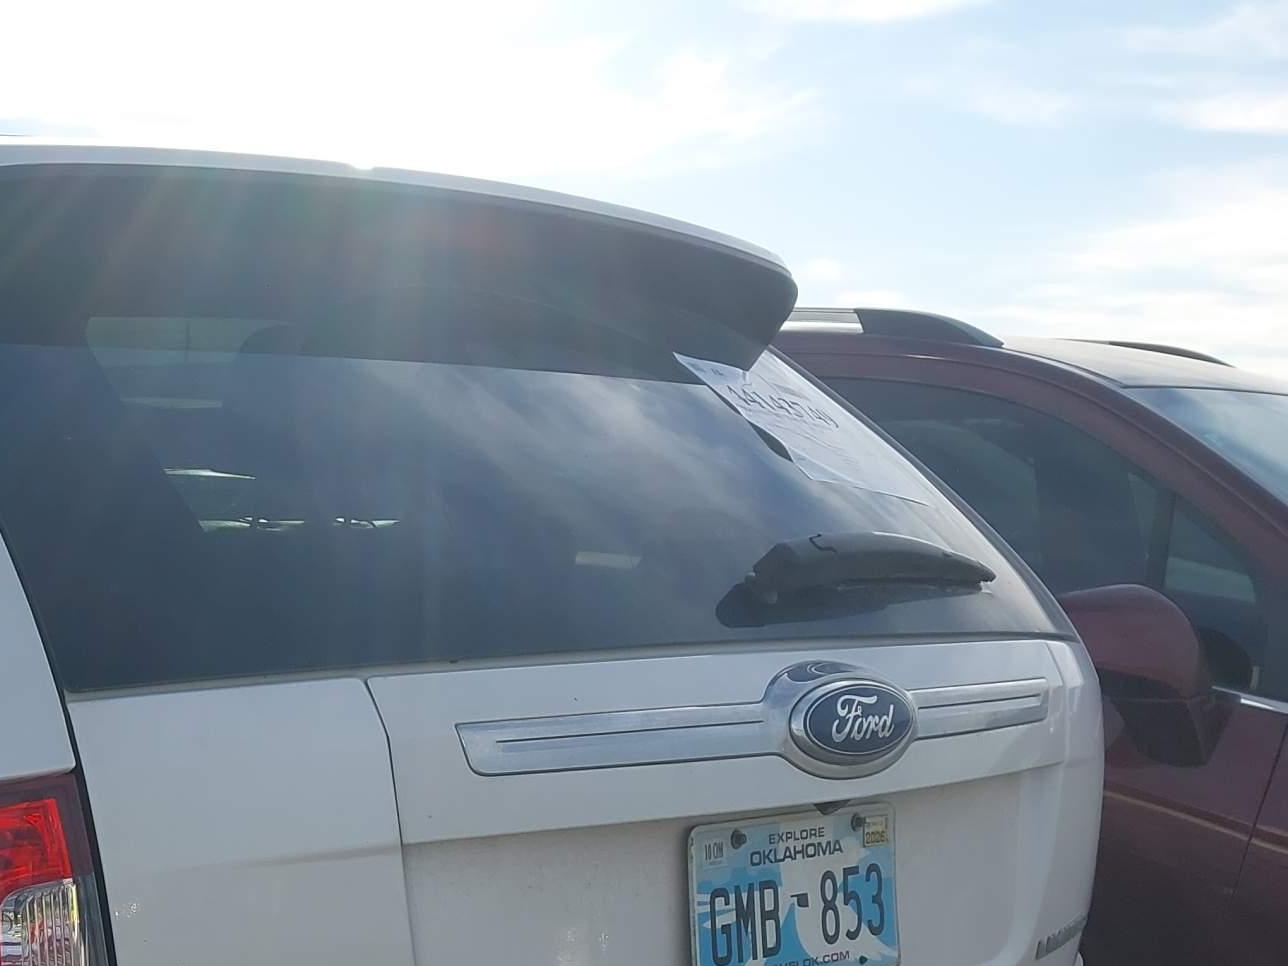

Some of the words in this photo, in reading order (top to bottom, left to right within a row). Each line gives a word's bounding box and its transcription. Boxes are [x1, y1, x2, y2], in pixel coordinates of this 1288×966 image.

[832, 694, 895, 742] Ford
[750, 839, 844, 866] OKLAHOMA
[768, 826, 825, 845] EXPLORE
[710, 880, 781, 966] GMB
[820, 863, 885, 945] 853
